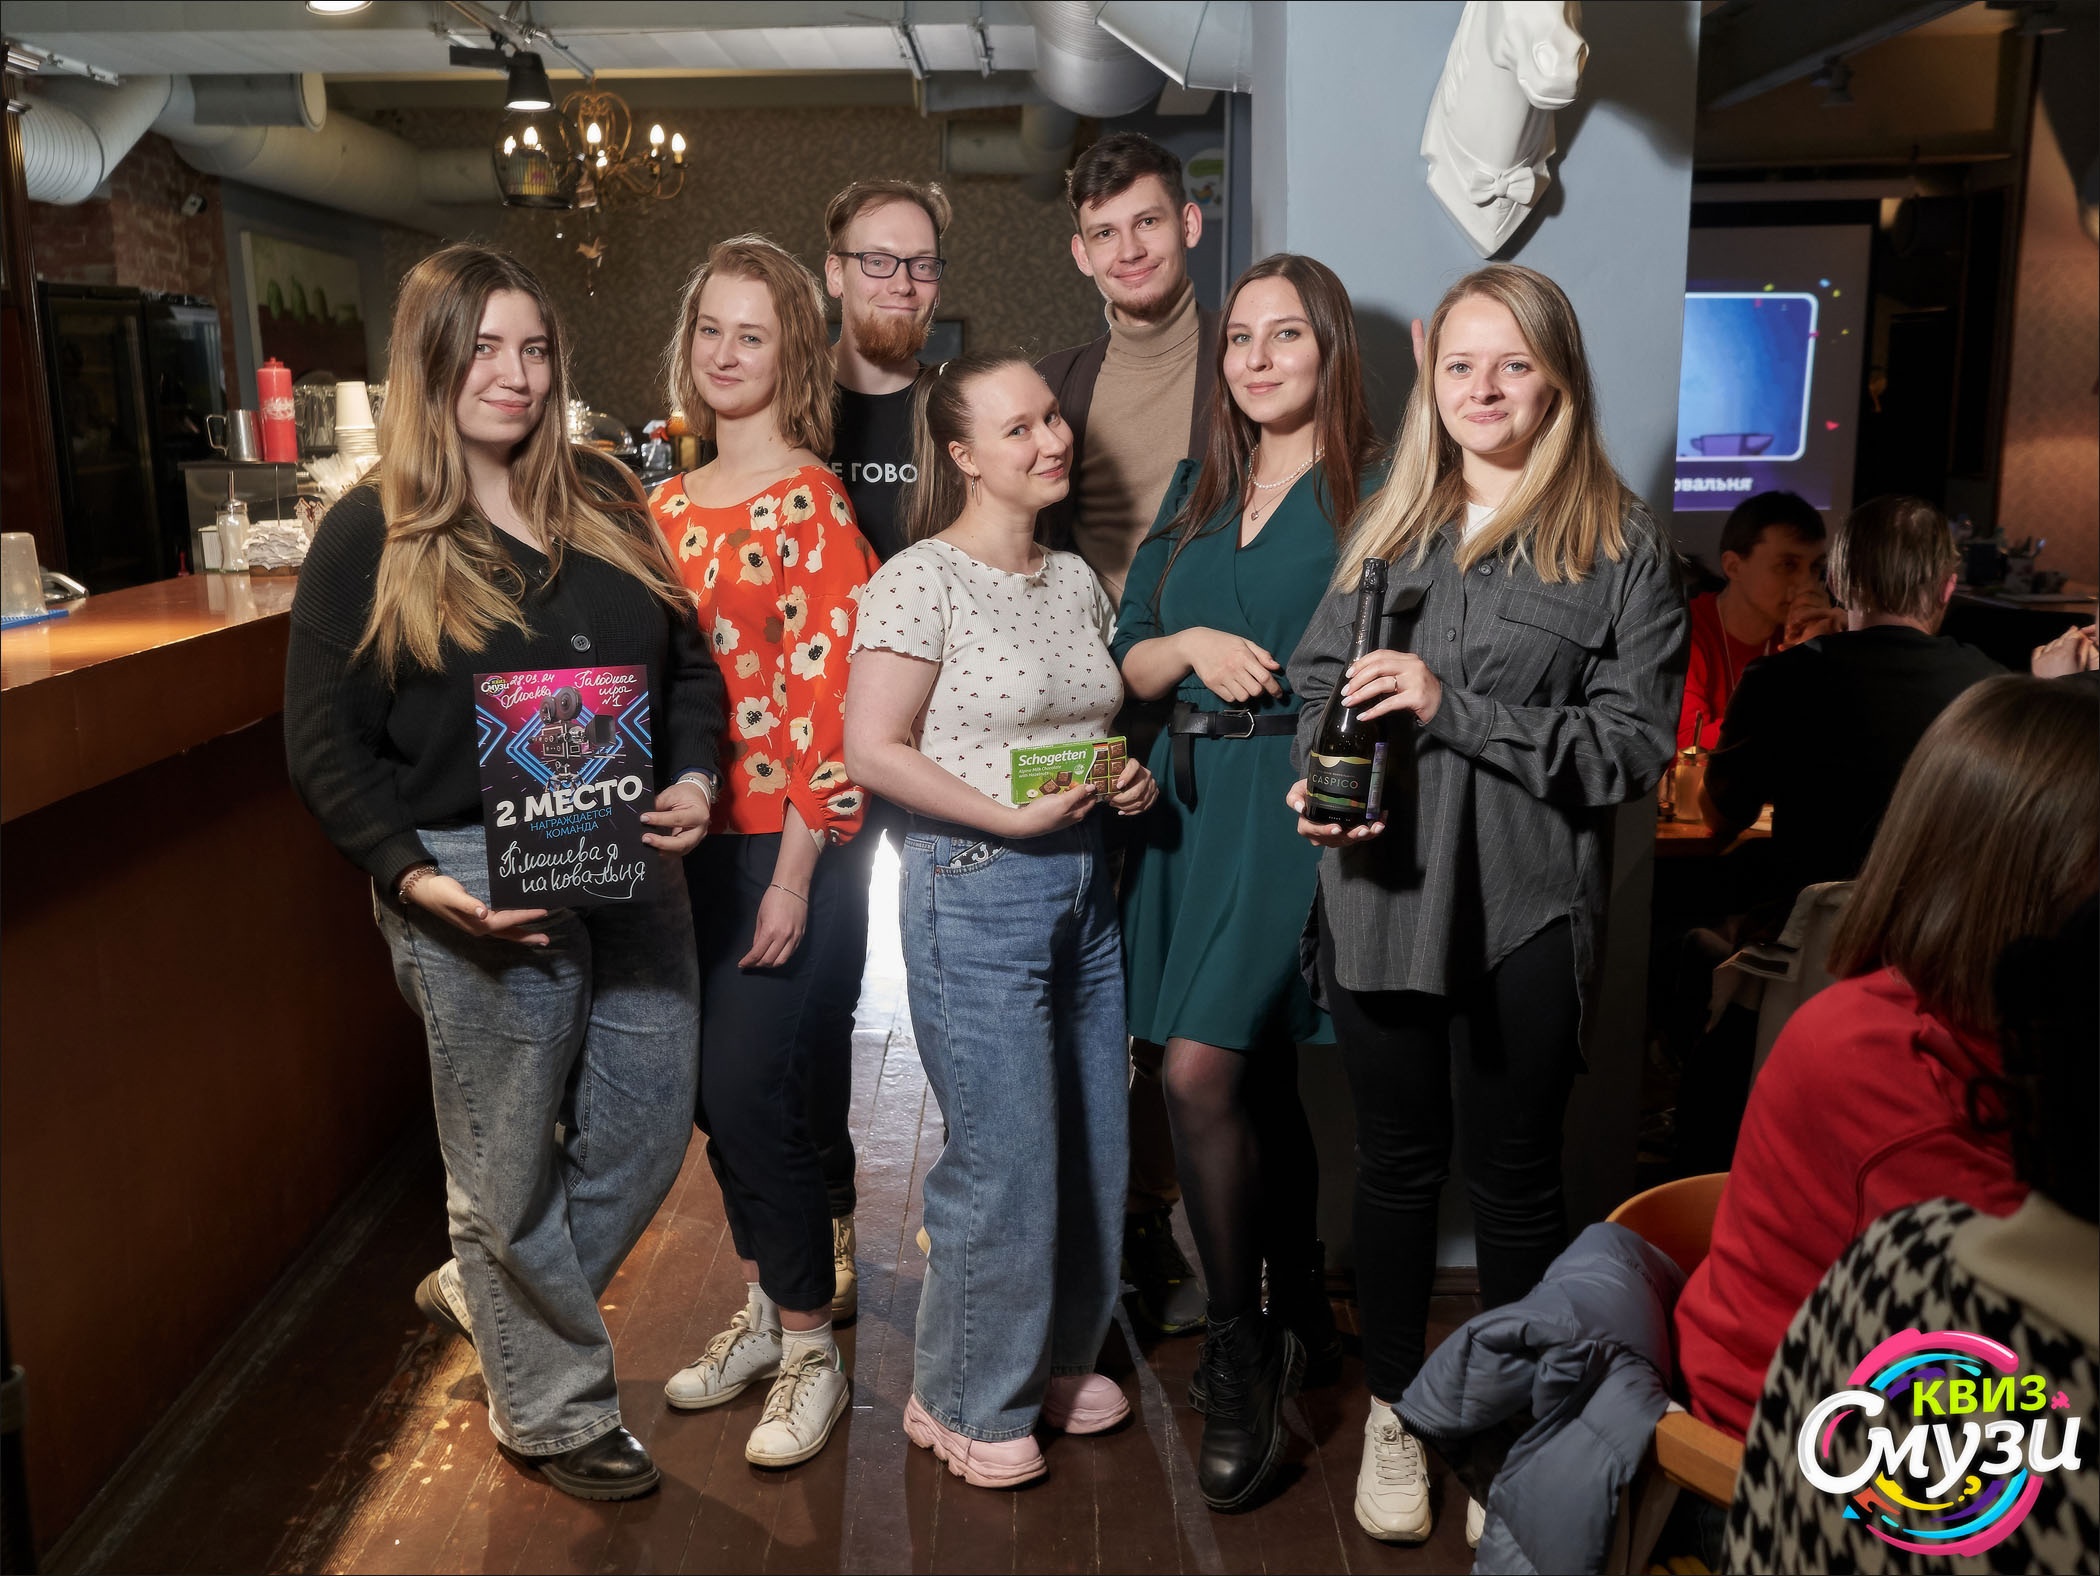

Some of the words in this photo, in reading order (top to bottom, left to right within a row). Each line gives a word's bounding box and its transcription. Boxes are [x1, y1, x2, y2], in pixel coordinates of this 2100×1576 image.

[851, 462, 918, 483] ГОВО
[501, 685, 552, 710] Москва
[1018, 750, 1086, 766] Schogetten
[1312, 774, 1358, 789] CASPICO
[496, 800, 517, 828] 2
[523, 775, 643, 822] МЕСТО
[530, 807, 613, 832] НАГРАЖДАЕТСЯ
[545, 821, 599, 839] КОМАНДА
[522, 861, 646, 899] наковальня
